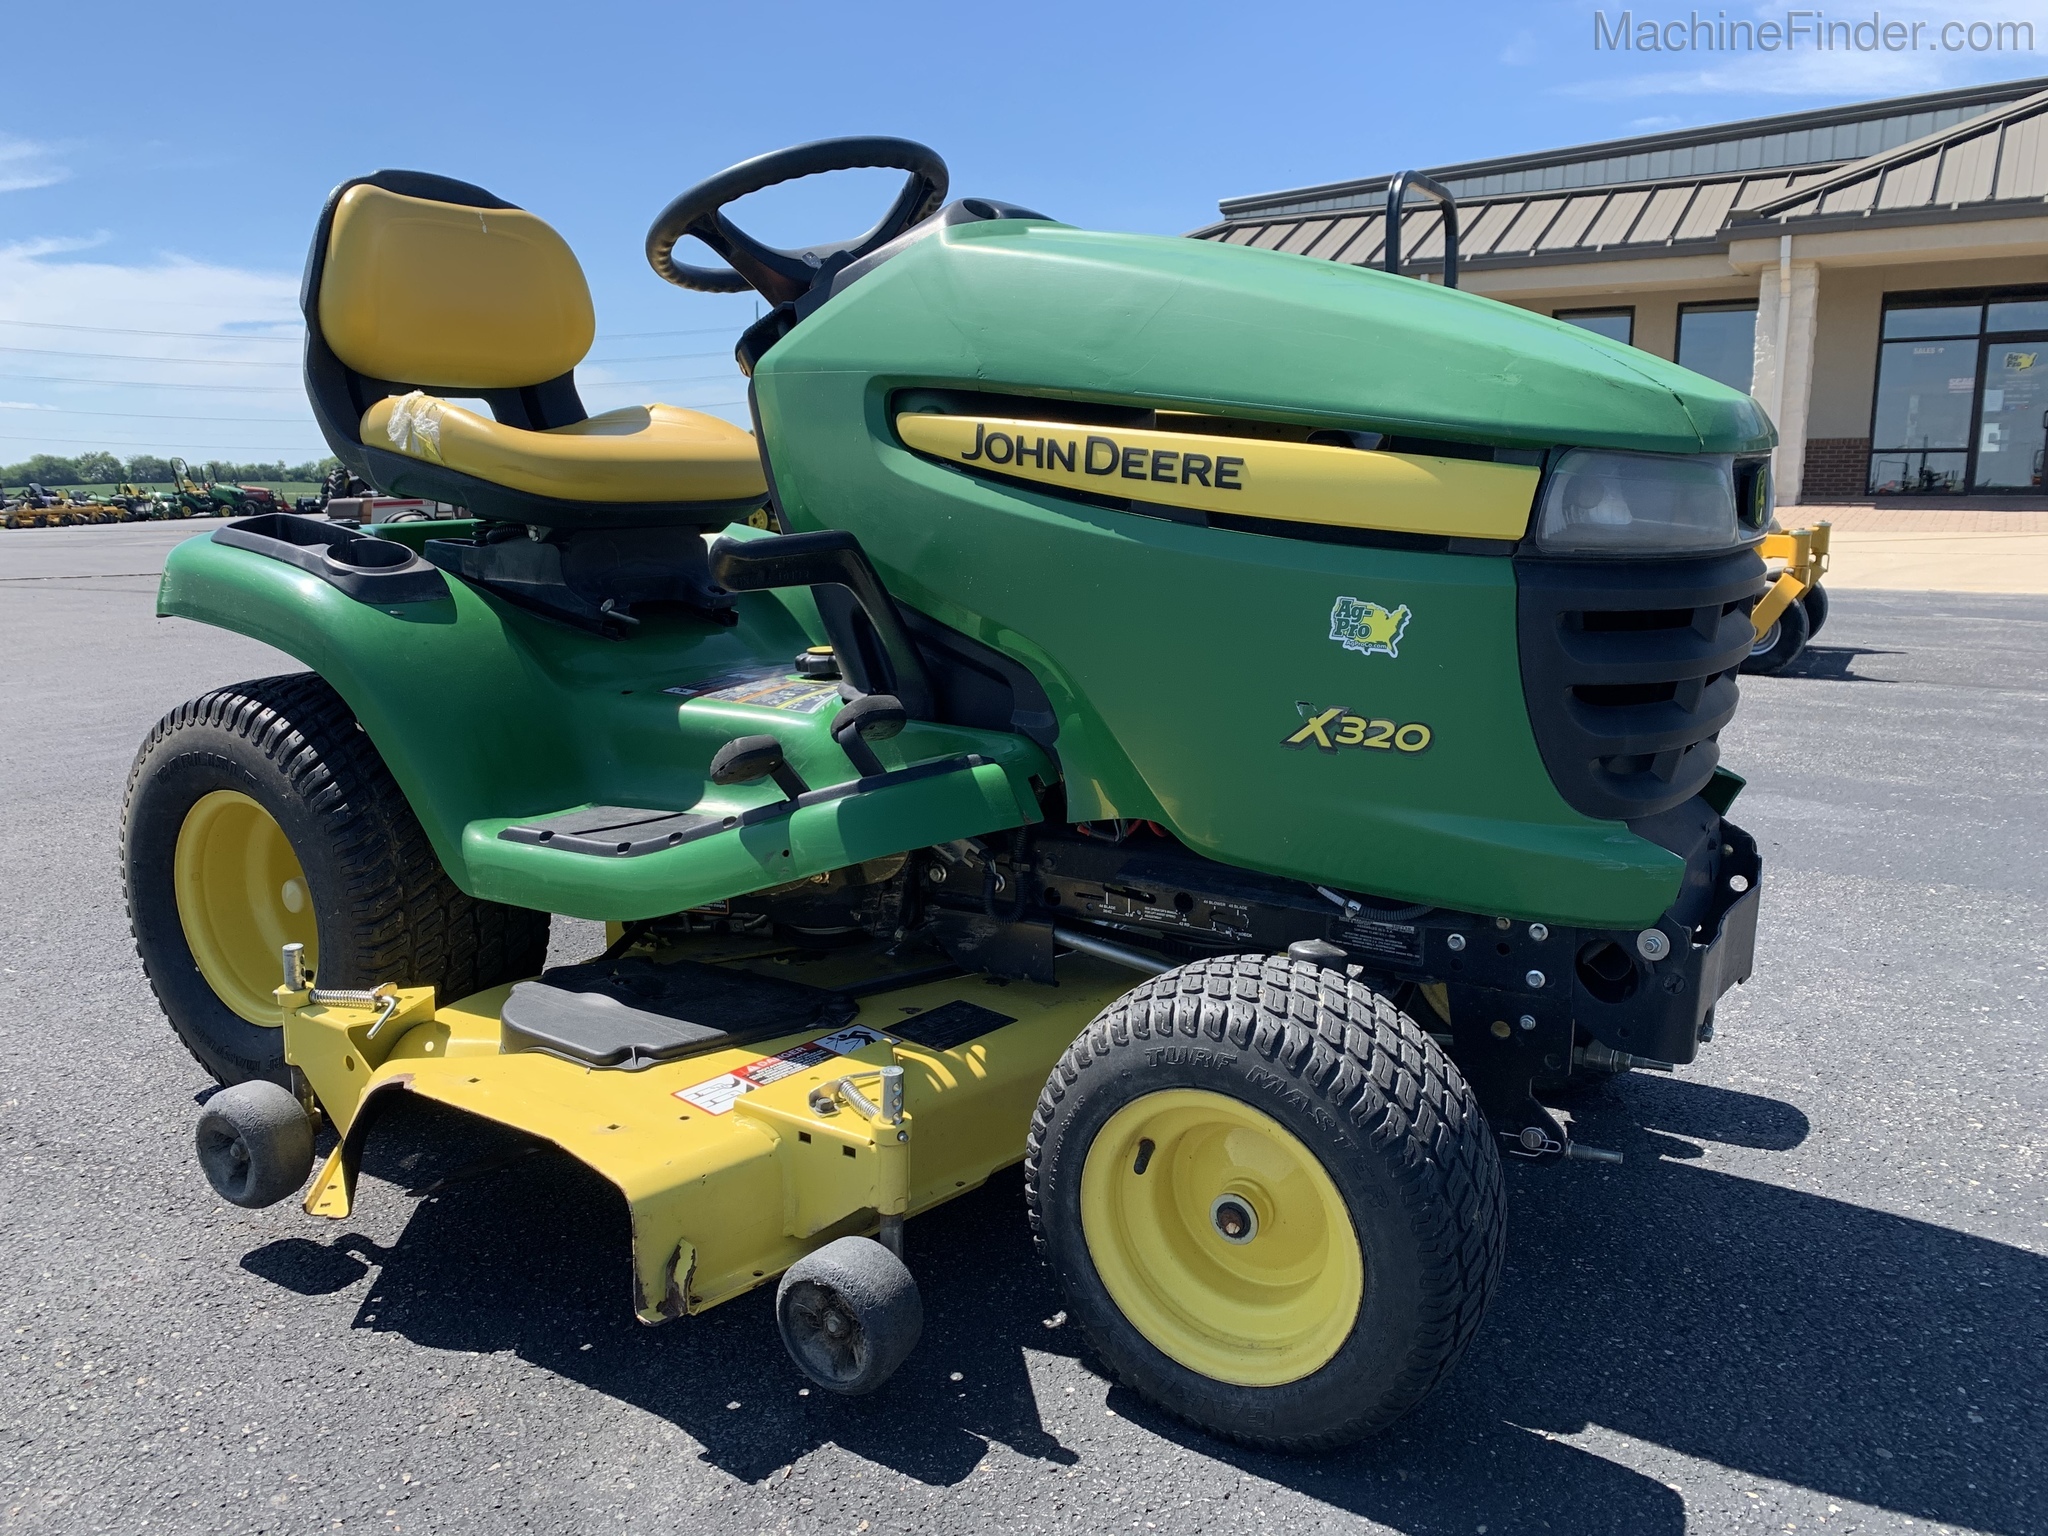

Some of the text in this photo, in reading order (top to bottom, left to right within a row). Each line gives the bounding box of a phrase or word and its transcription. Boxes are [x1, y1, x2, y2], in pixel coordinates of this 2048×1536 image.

[961, 423, 1244, 491] JOHN DEERE
[1332, 618, 1372, 639] Pro
[1345, 639, 1388, 649] AgProCo.com
[1283, 704, 1433, 755] X320
[757, 1047, 808, 1067] DANGER
[1145, 1046, 1237, 1071] TURF
